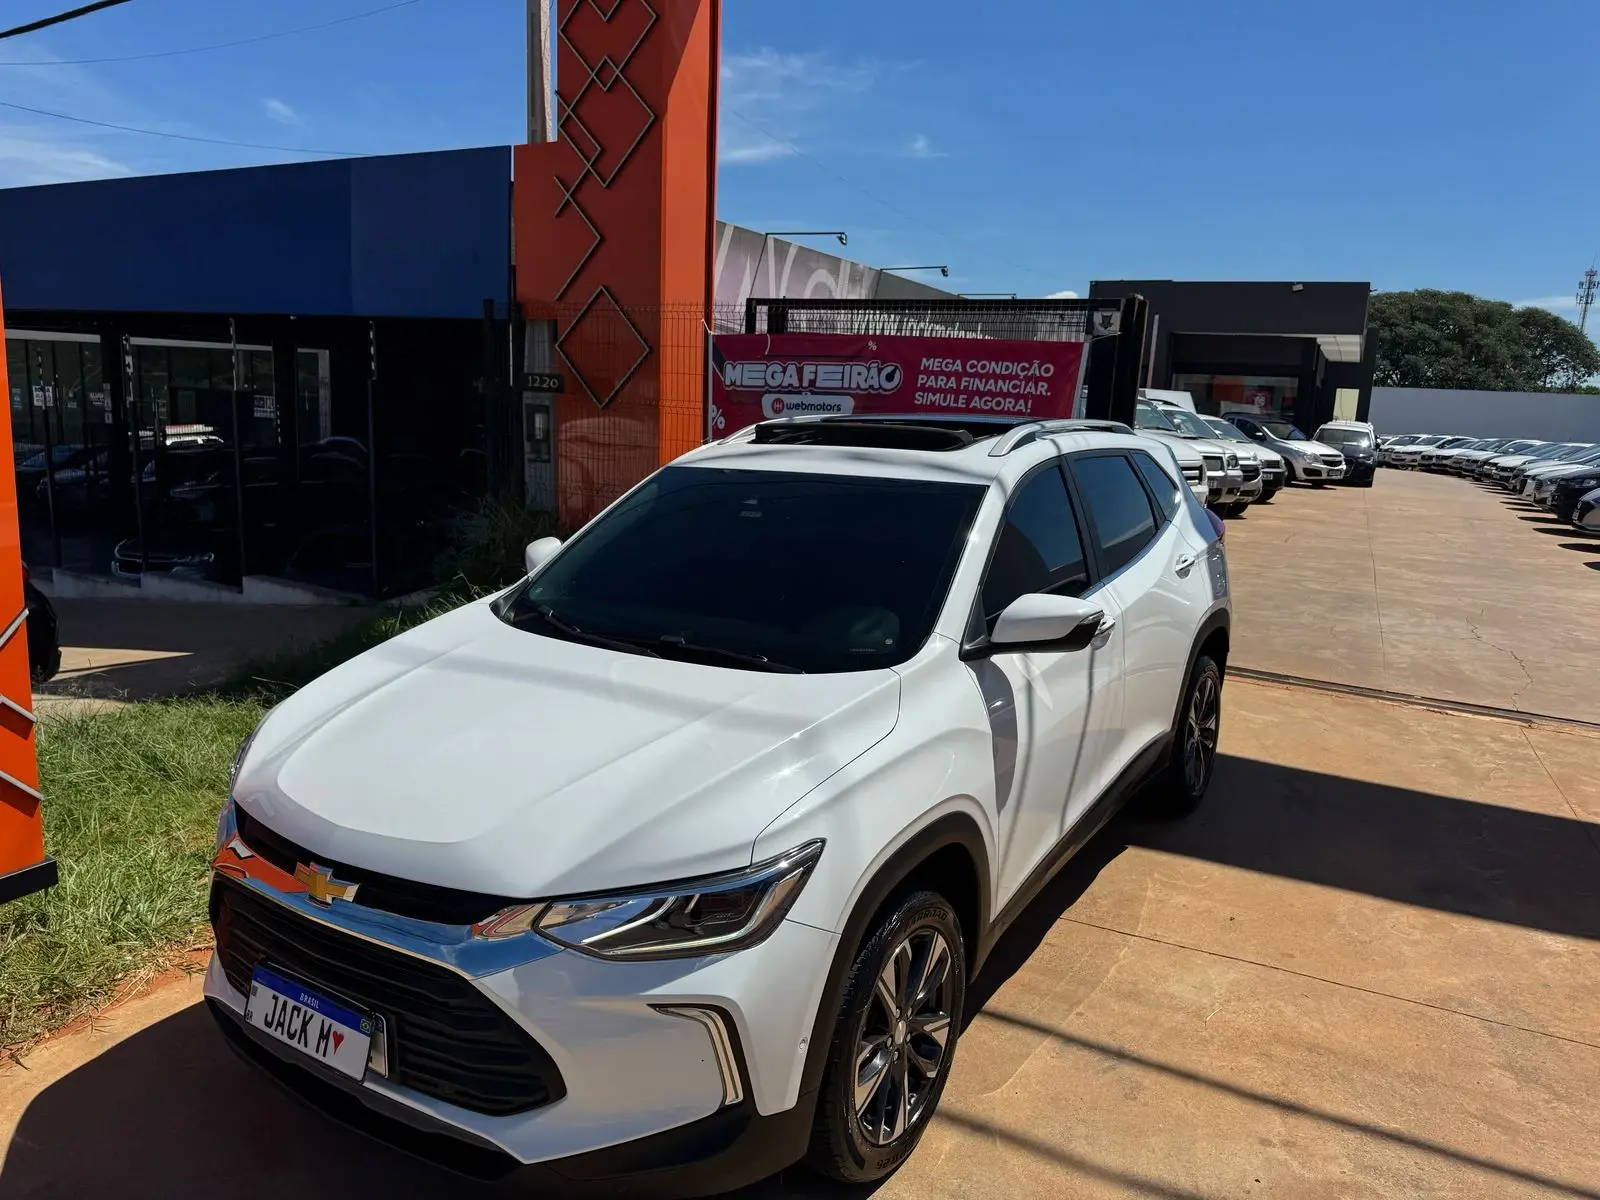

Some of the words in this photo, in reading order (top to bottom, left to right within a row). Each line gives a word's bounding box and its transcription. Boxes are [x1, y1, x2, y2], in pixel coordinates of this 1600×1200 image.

[868, 340, 877, 350] %
[724, 362, 800, 388] MEGA
[920, 357, 963, 373] MEGA
[965, 360, 1054, 379] CONDIÇÃO
[528, 375, 559, 389] 1220
[917, 374, 957, 390] PARA
[960, 377, 1052, 396] FINANCIAR.
[786, 400, 842, 413] webmotors
[914, 391, 966, 408] SIMULE
[969, 395, 1032, 413] AGORA!
[299, 992, 320, 1009] BRASIL
[245, 1009, 254, 1022] BR
[264, 994, 314, 1048] JACK
[315, 1019, 333, 1058] M
